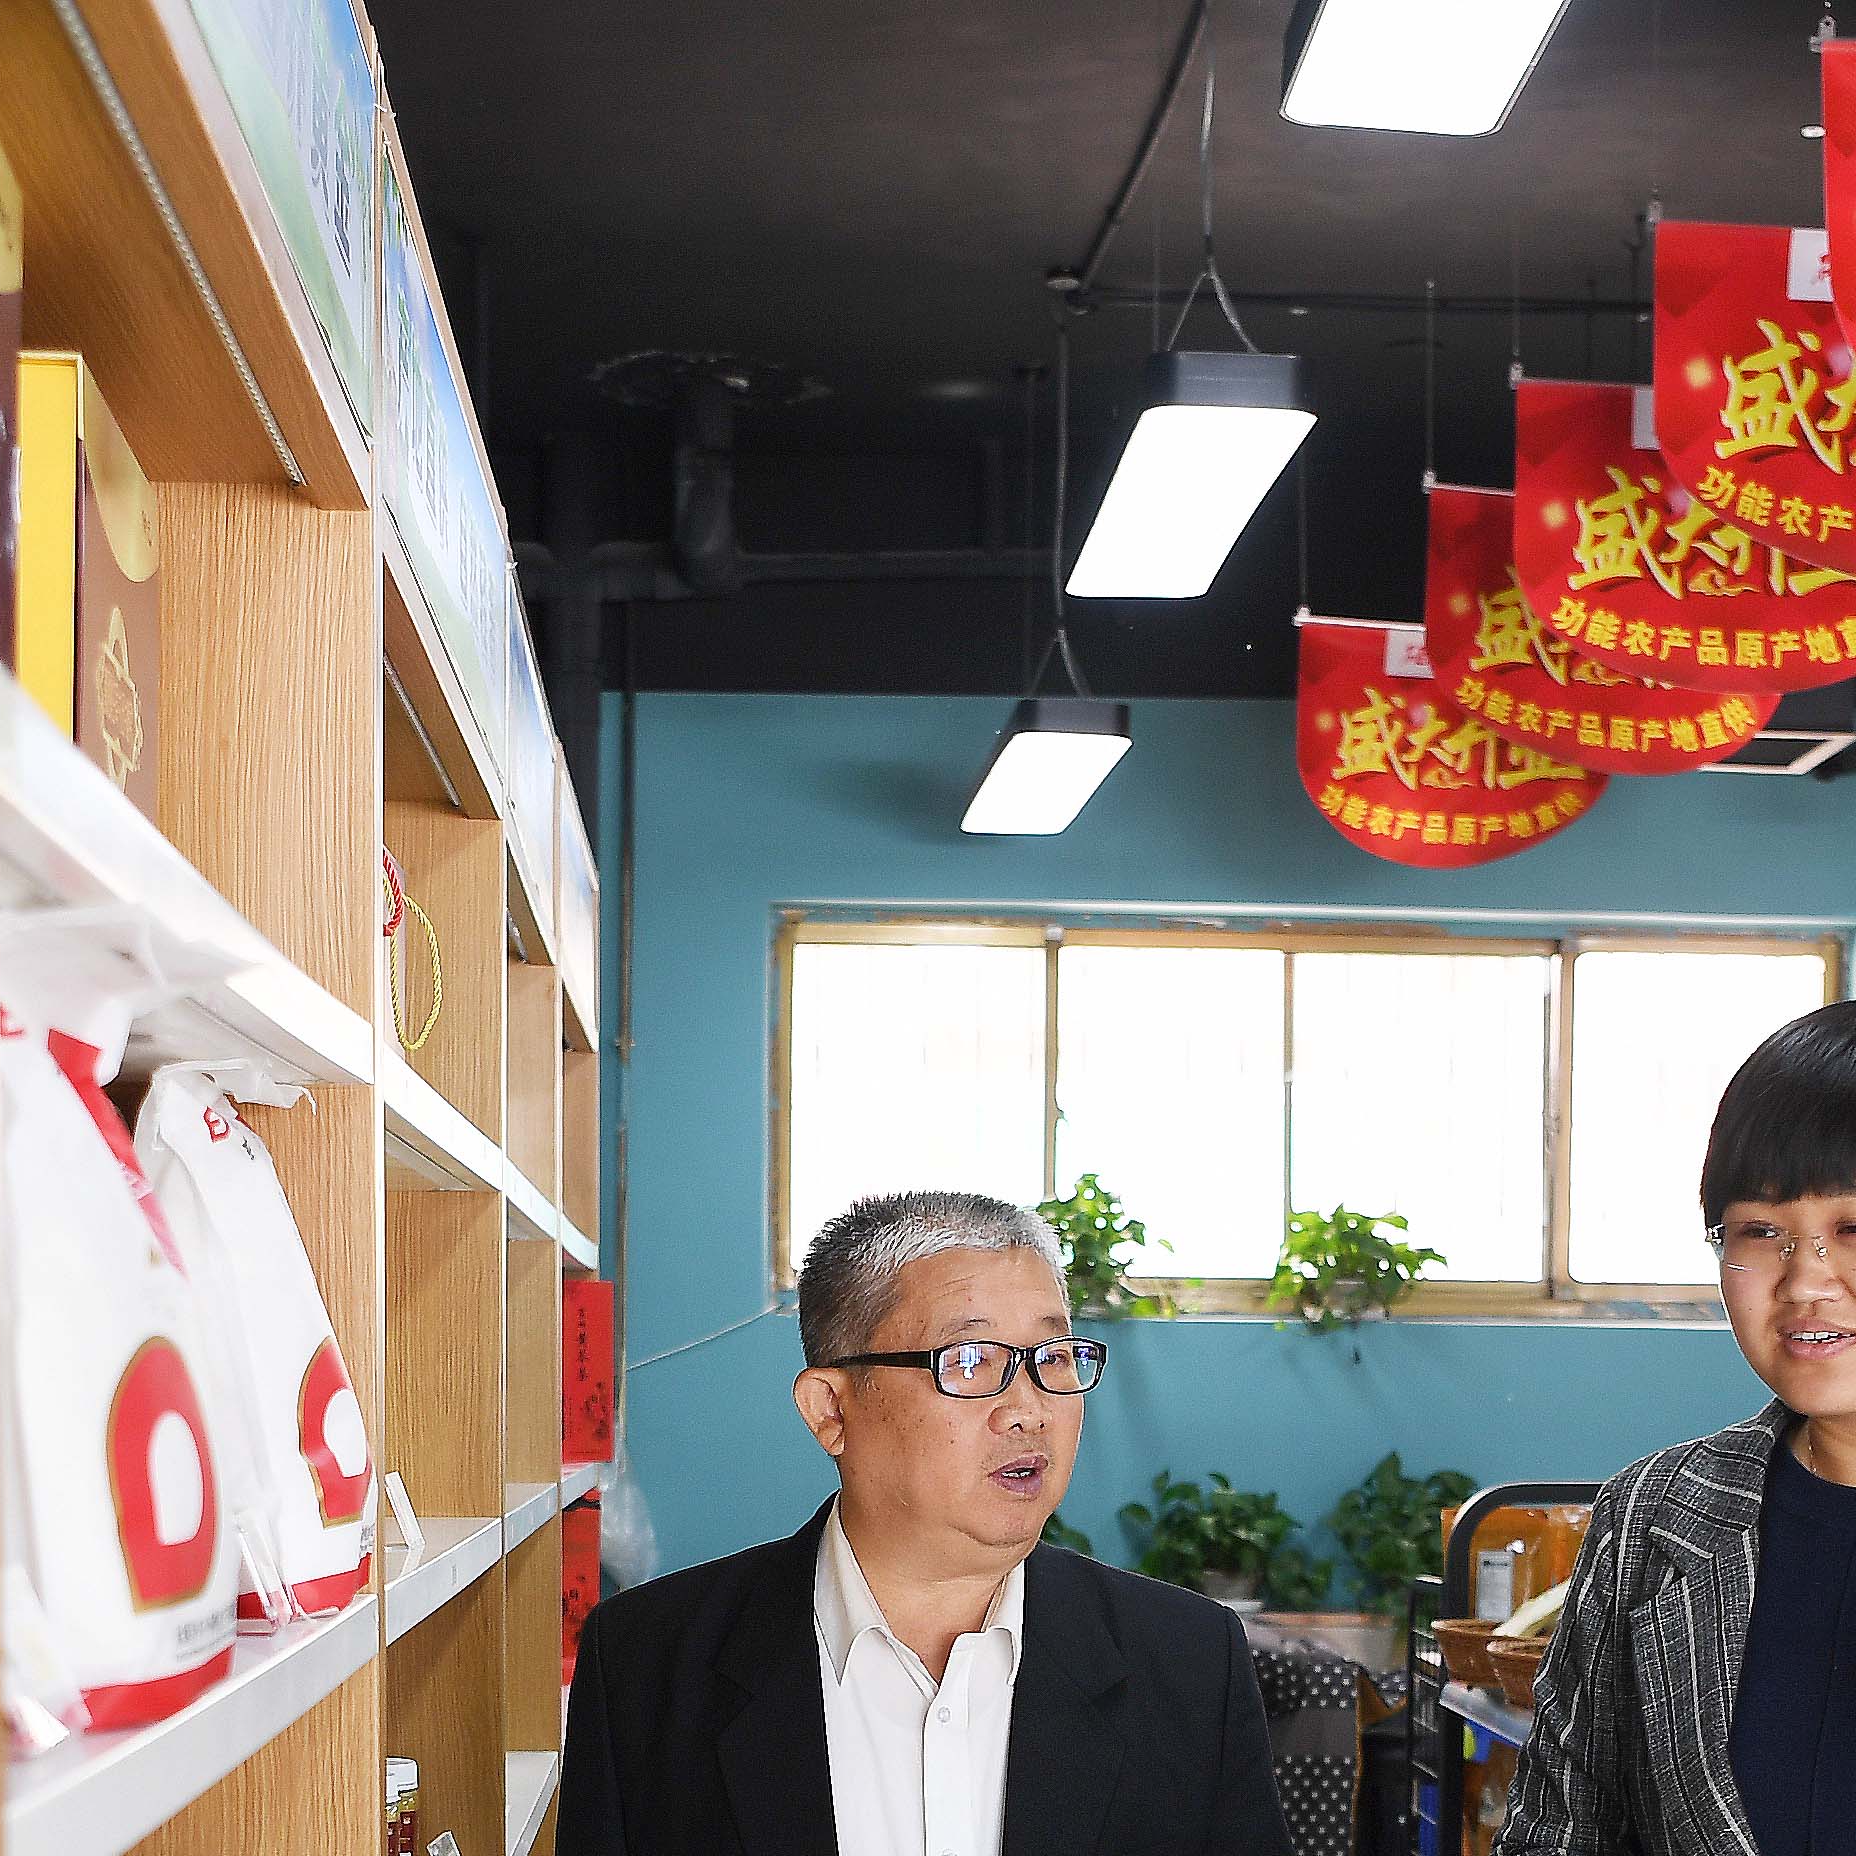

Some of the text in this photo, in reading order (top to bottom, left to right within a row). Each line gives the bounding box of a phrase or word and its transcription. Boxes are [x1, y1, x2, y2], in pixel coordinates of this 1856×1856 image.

[1456, 676, 1756, 754] 功能农产品原产地直供
[1318, 784, 1584, 847] 功能农产品原产地直供
